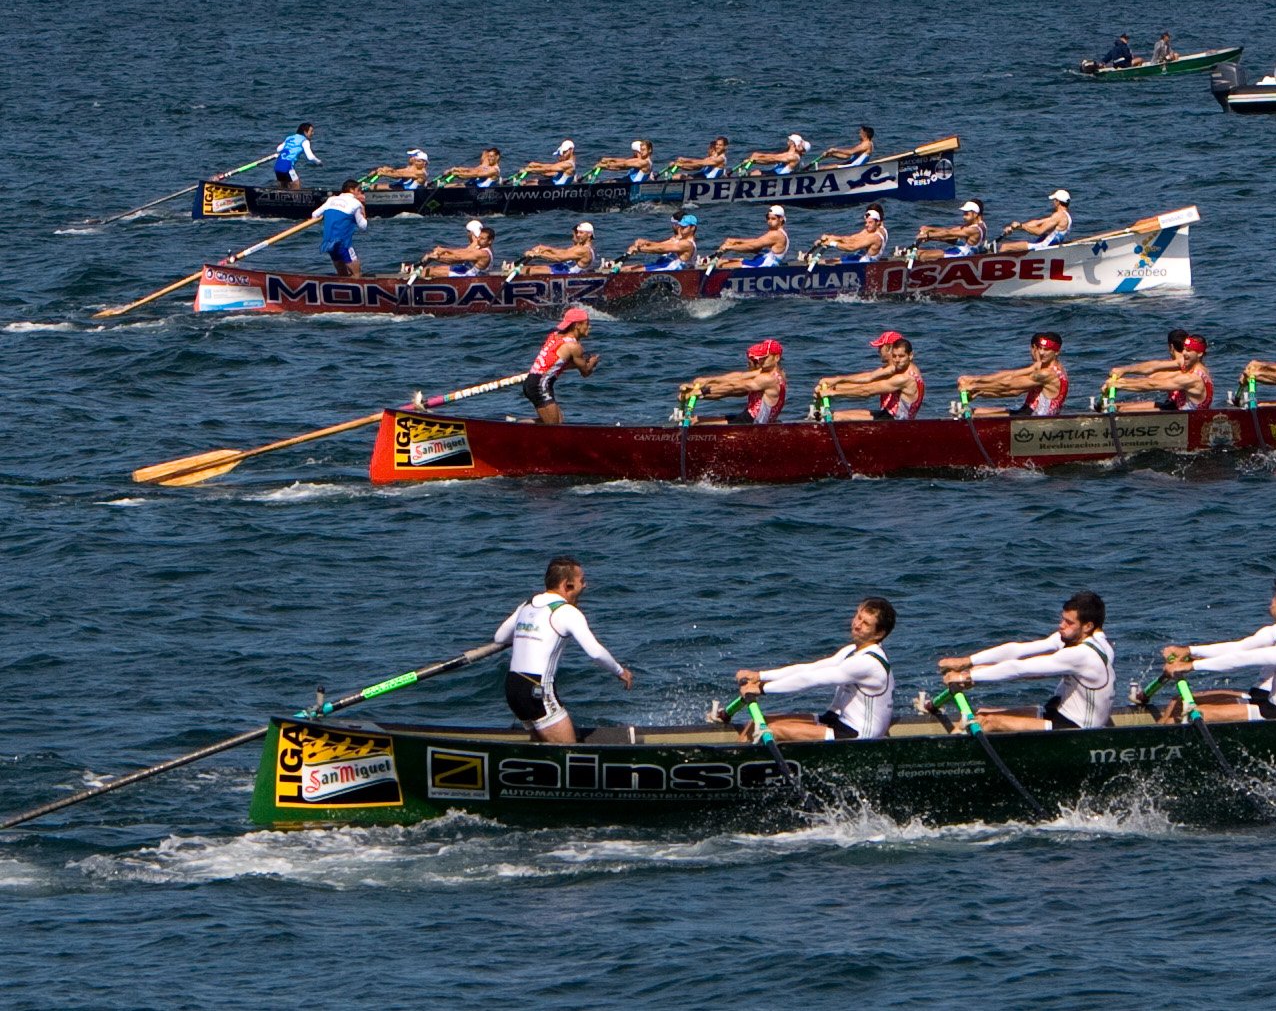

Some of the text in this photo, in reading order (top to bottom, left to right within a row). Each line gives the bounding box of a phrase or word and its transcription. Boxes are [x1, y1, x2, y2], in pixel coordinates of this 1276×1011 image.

[204, 185, 214, 214] LIGA
[504, 187, 627, 201] www.opirata.com
[687, 173, 841, 202] PEREIRA
[729, 271, 861, 292] TECNOLAR
[884, 258, 1073, 293] ISABEL
[1117, 267, 1167, 277] xacobeo
[266, 274, 608, 307] MONDARIZ
[396, 417, 412, 467] LIGA
[1039, 425, 1161, 443] NATUR HOUSE
[278, 725, 304, 803] LIGA
[499, 753, 802, 790] ainse
